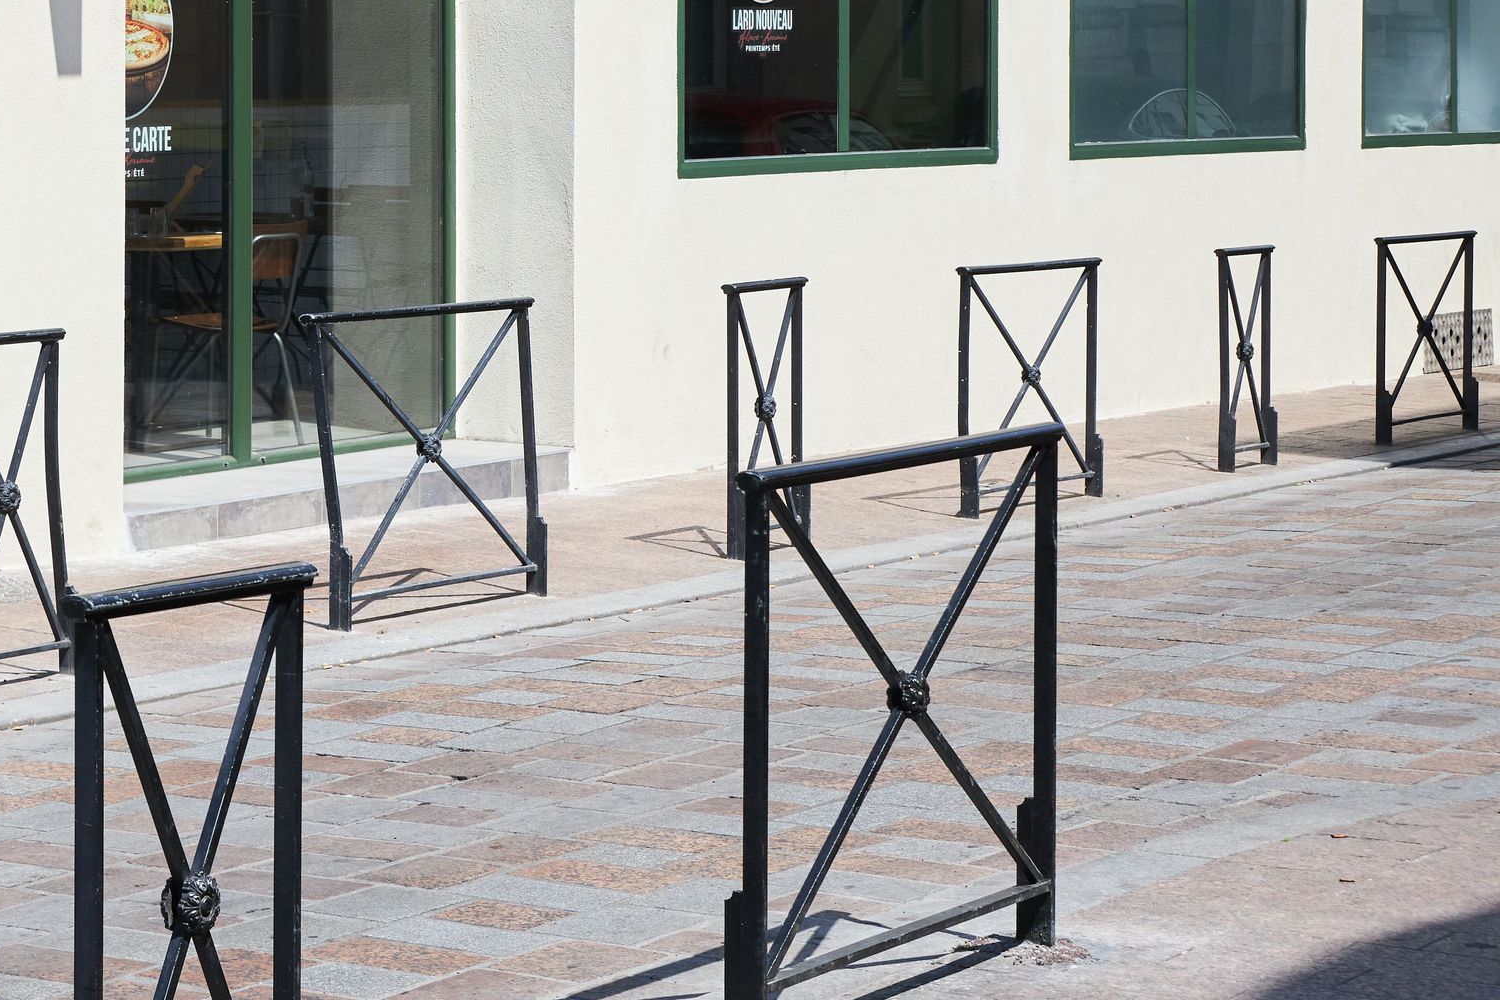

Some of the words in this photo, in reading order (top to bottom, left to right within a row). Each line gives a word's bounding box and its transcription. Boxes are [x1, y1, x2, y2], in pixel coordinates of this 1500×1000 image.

[732, 9, 754, 30] LARD
[755, 9, 793, 31] NOUVEAU
[133, 126, 172, 152] CARTE
[133, 168, 145, 177] ÉTÉ
